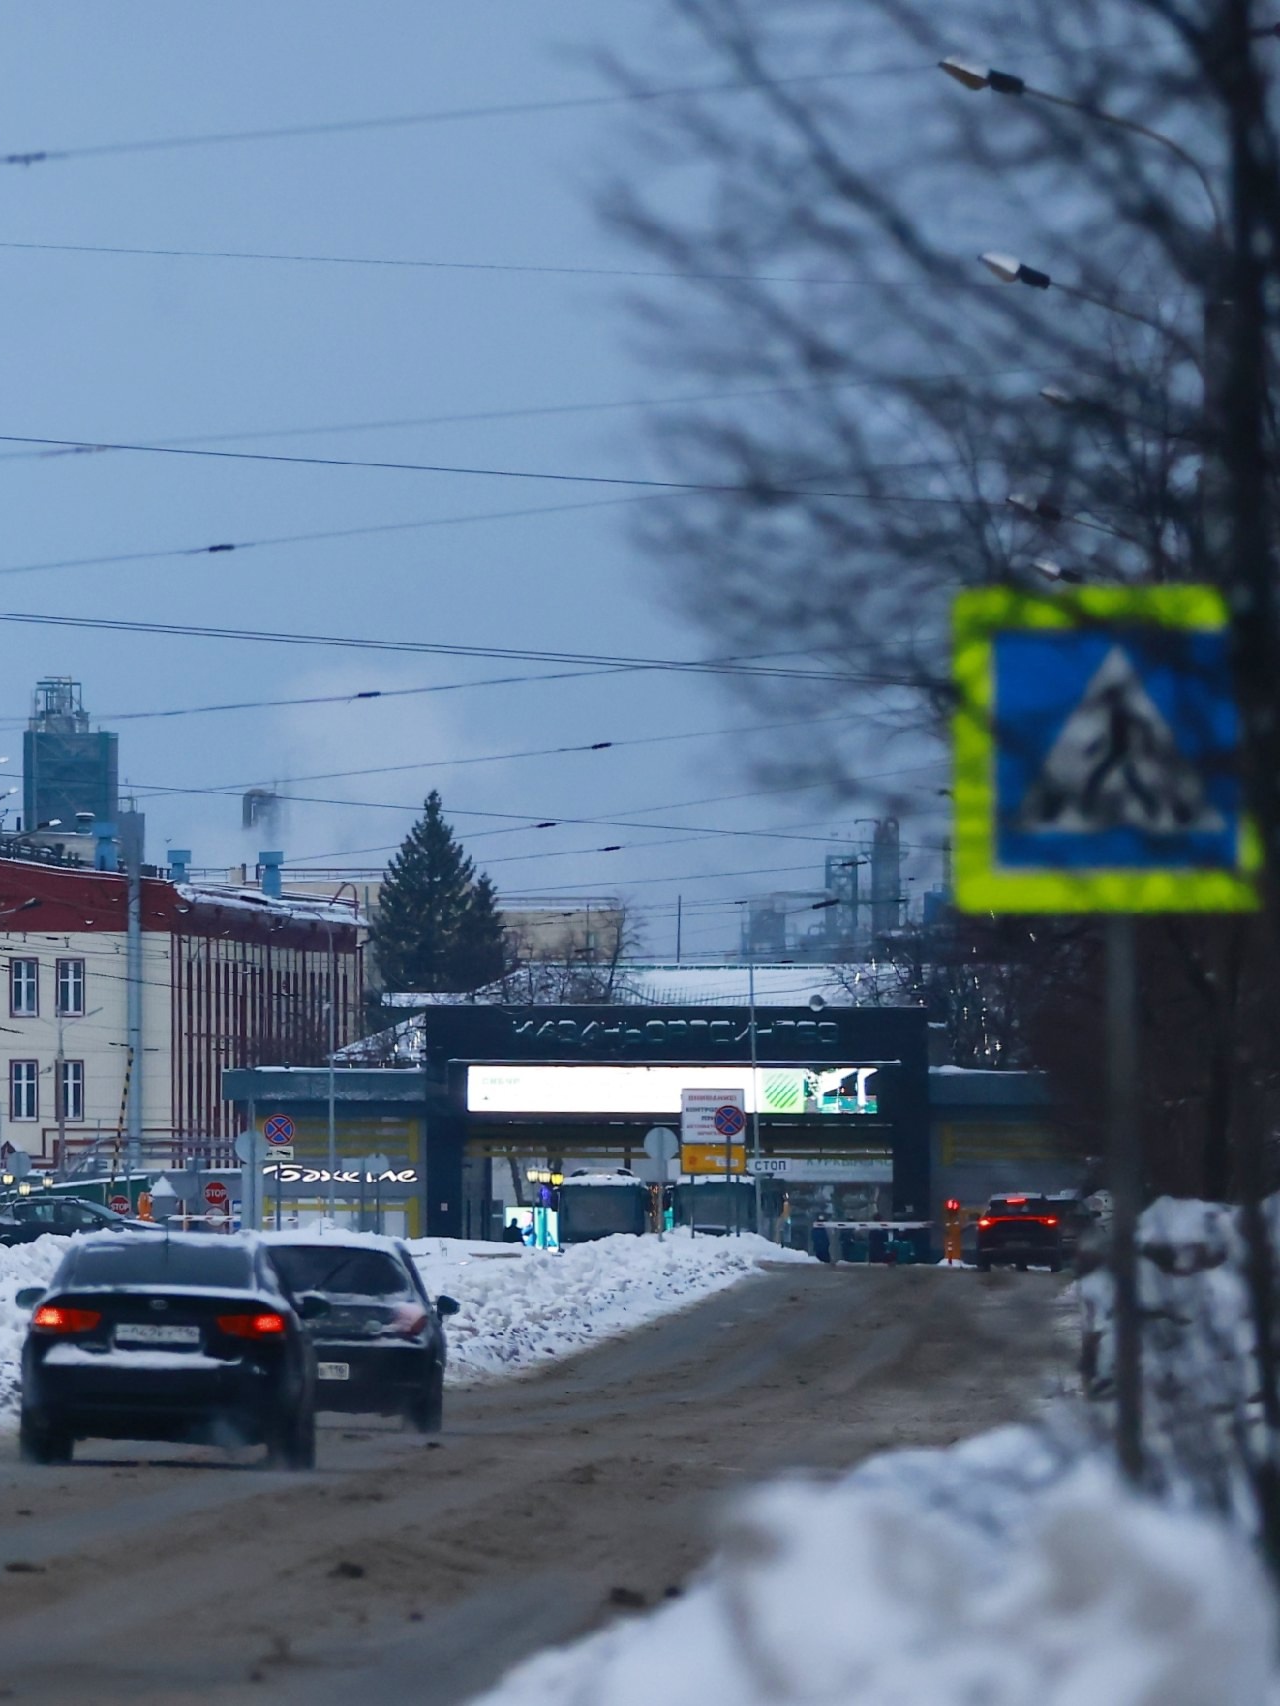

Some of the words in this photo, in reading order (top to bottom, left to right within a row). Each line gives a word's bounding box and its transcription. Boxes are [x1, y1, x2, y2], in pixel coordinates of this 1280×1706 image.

[754, 1160, 787, 1171] СТОП
[205, 1189, 227, 1198] STOP
[110, 1202, 130, 1211] STOP
